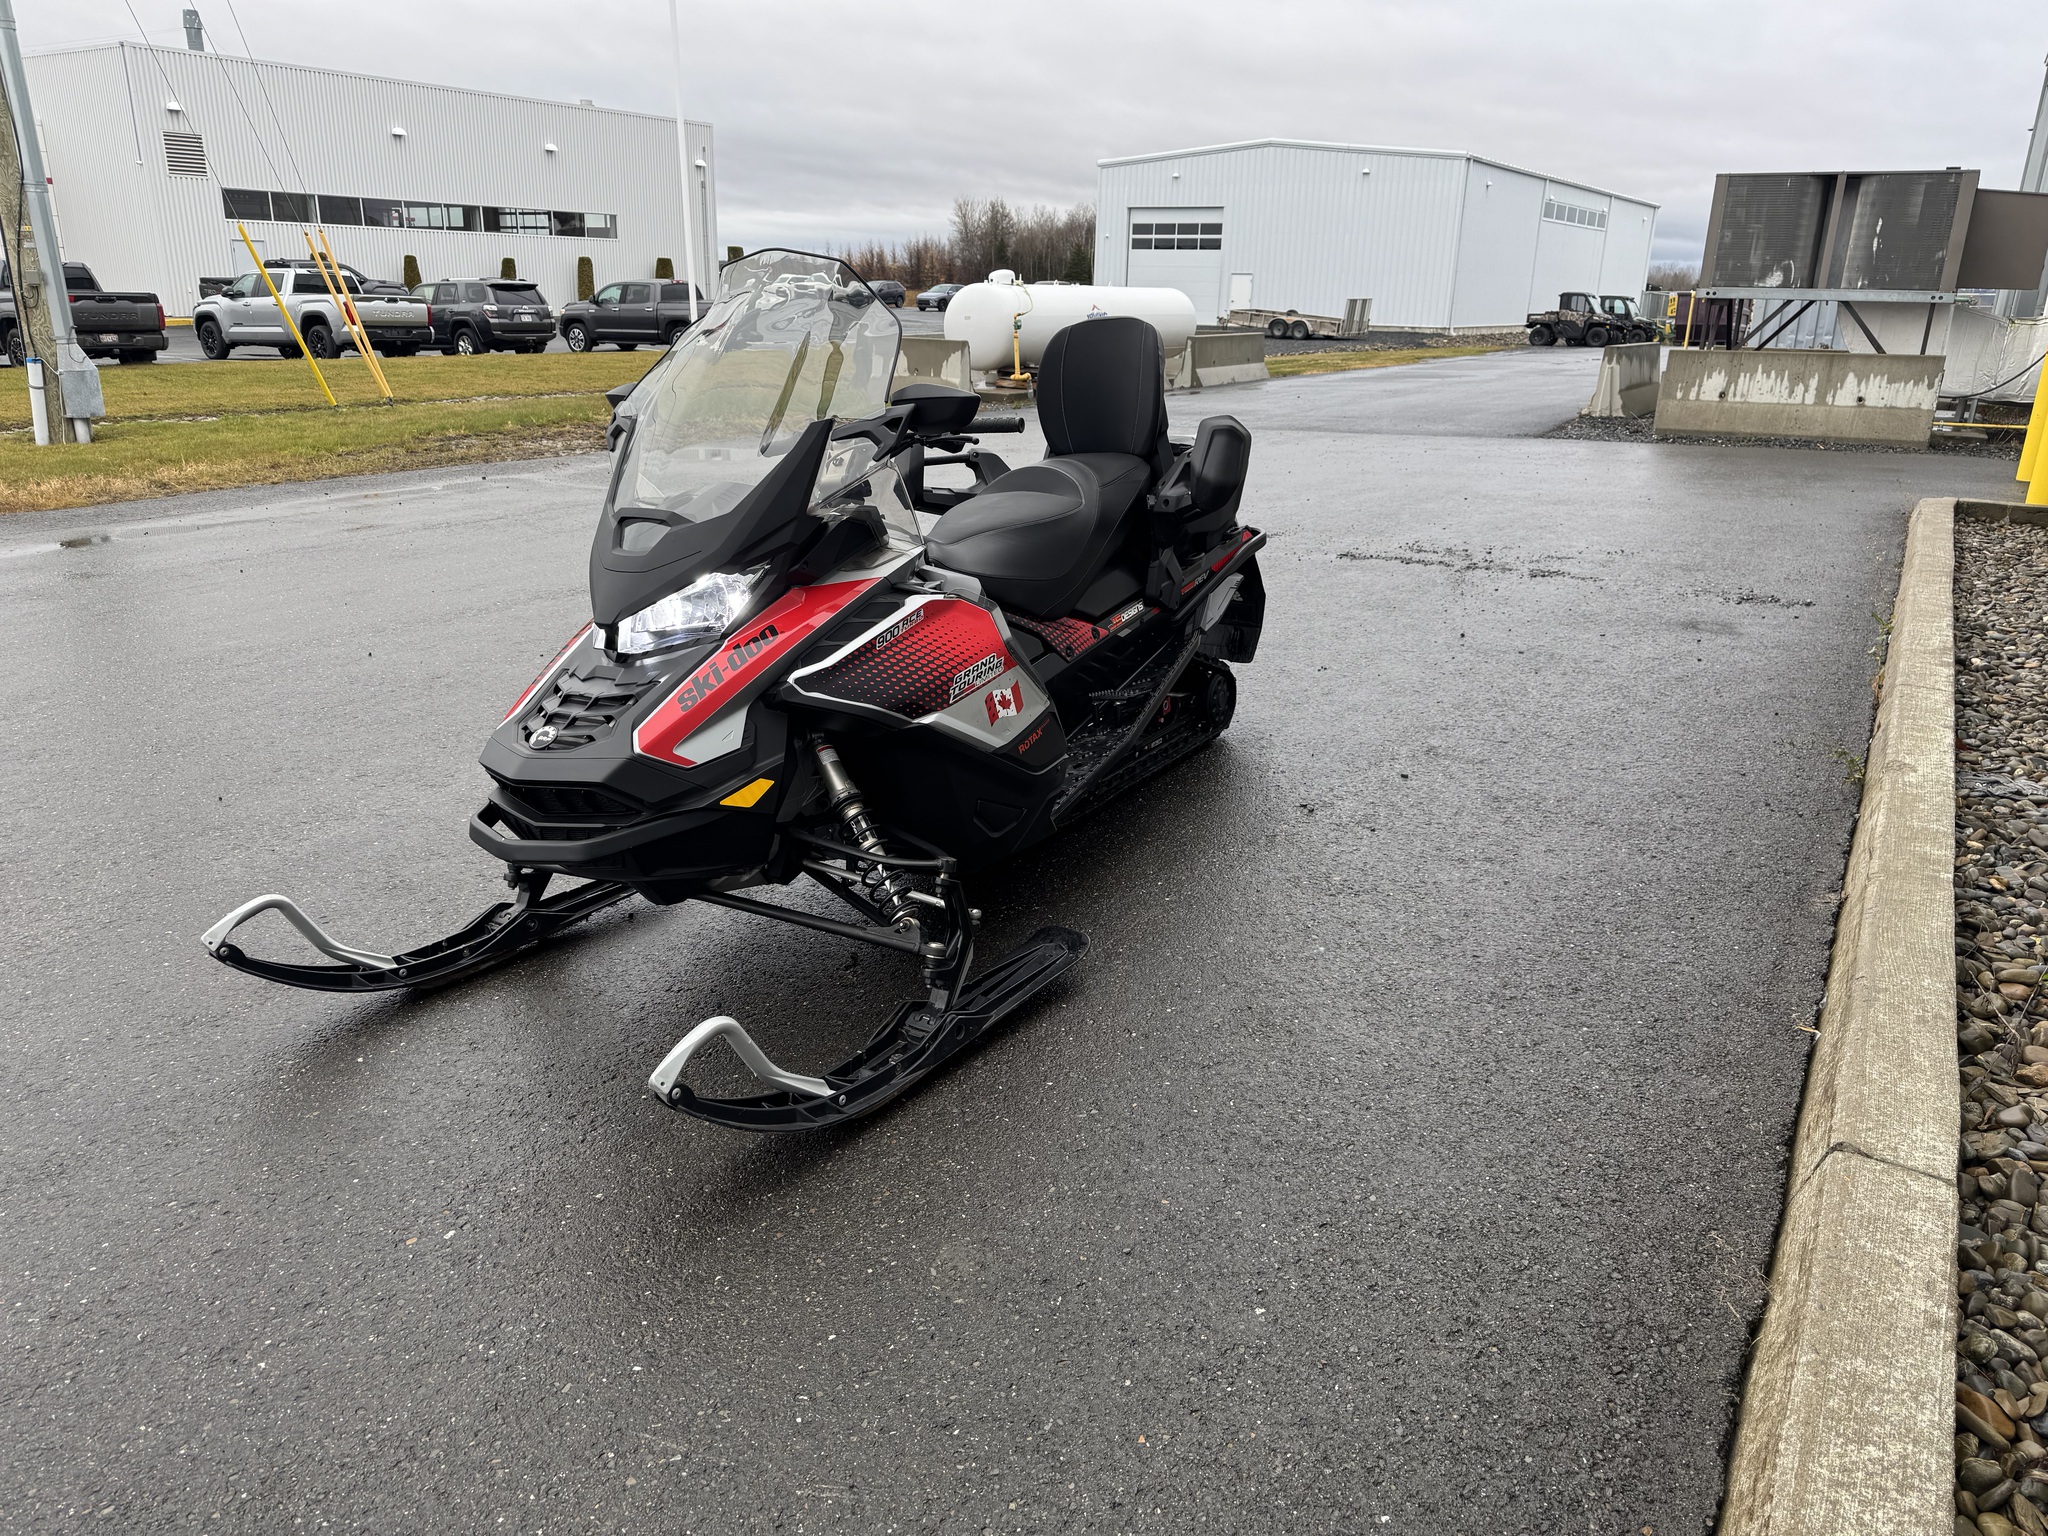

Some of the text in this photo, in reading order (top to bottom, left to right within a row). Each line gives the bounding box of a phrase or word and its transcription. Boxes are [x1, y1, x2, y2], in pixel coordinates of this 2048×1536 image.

[78, 312, 139, 320] TUNDRA
[372, 309, 415, 318] TUNDRA
[876, 609, 923, 649] 900 ACE
[677, 624, 779, 712] ski-doo
[950, 658, 1003, 695] TOURING
[954, 654, 997, 685] GRAND
[1018, 726, 1043, 754] ROTAX
